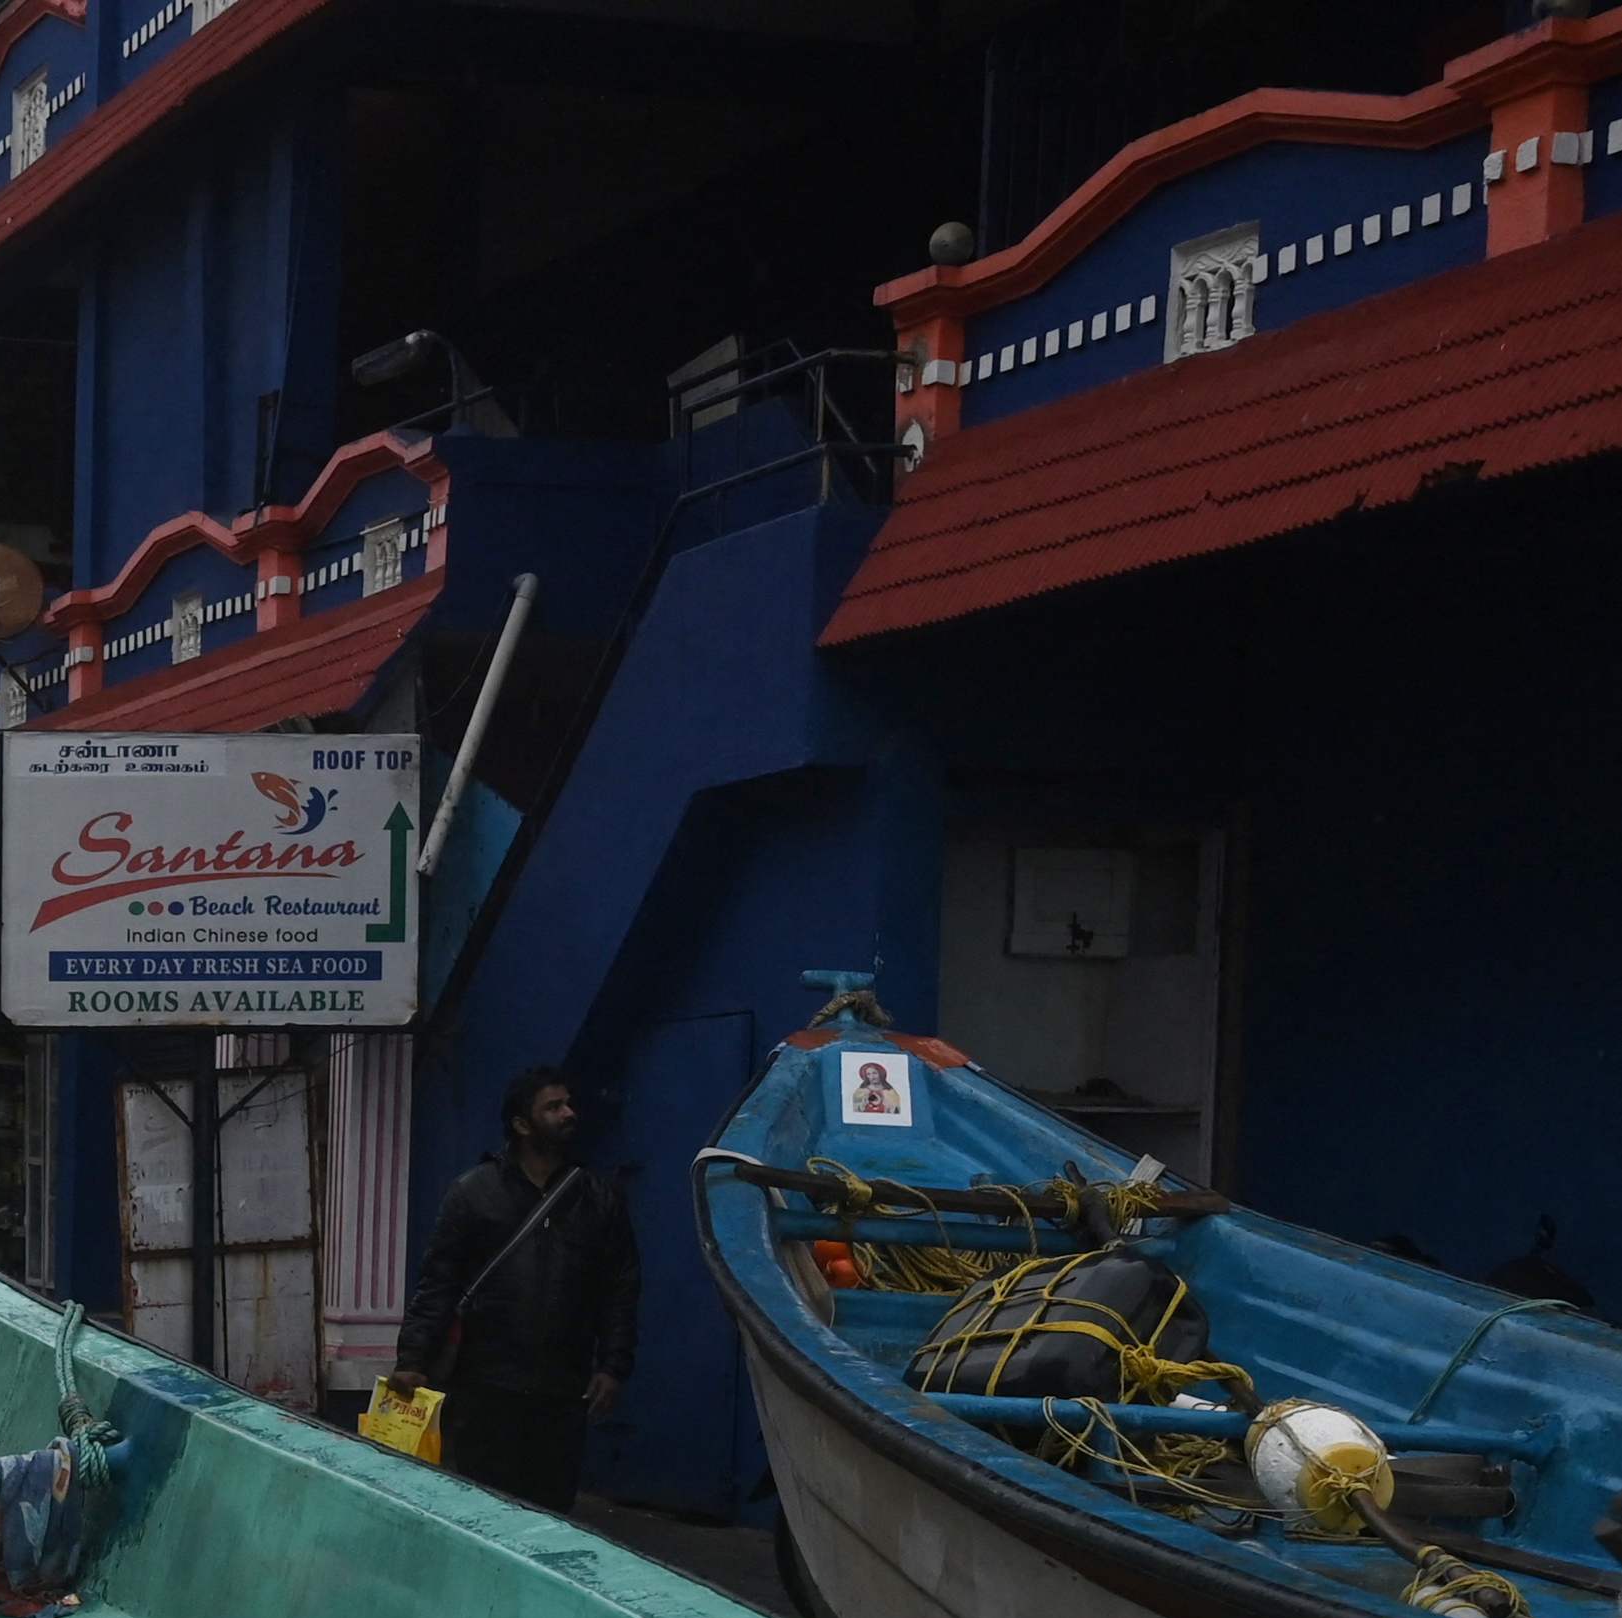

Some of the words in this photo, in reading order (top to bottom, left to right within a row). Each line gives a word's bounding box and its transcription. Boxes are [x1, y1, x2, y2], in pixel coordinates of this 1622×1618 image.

[312, 749, 366, 772] ROOF
[374, 749, 413, 772] TOP
[51, 811, 365, 886] Santana
[189, 894, 255, 918] Beach
[265, 894, 381, 918] Restaurant
[125, 927, 187, 944] Indian
[193, 927, 269, 944] Chinese
[275, 927, 319, 944] food
[65, 957, 135, 977] EVERY
[142, 957, 186, 976] DAY
[193, 957, 260, 975] FRESH
[265, 957, 305, 975] SEA
[311, 956, 368, 975] FOOD
[68, 990, 179, 1013] ROOMS
[188, 989, 365, 1013] AVAILABLE
